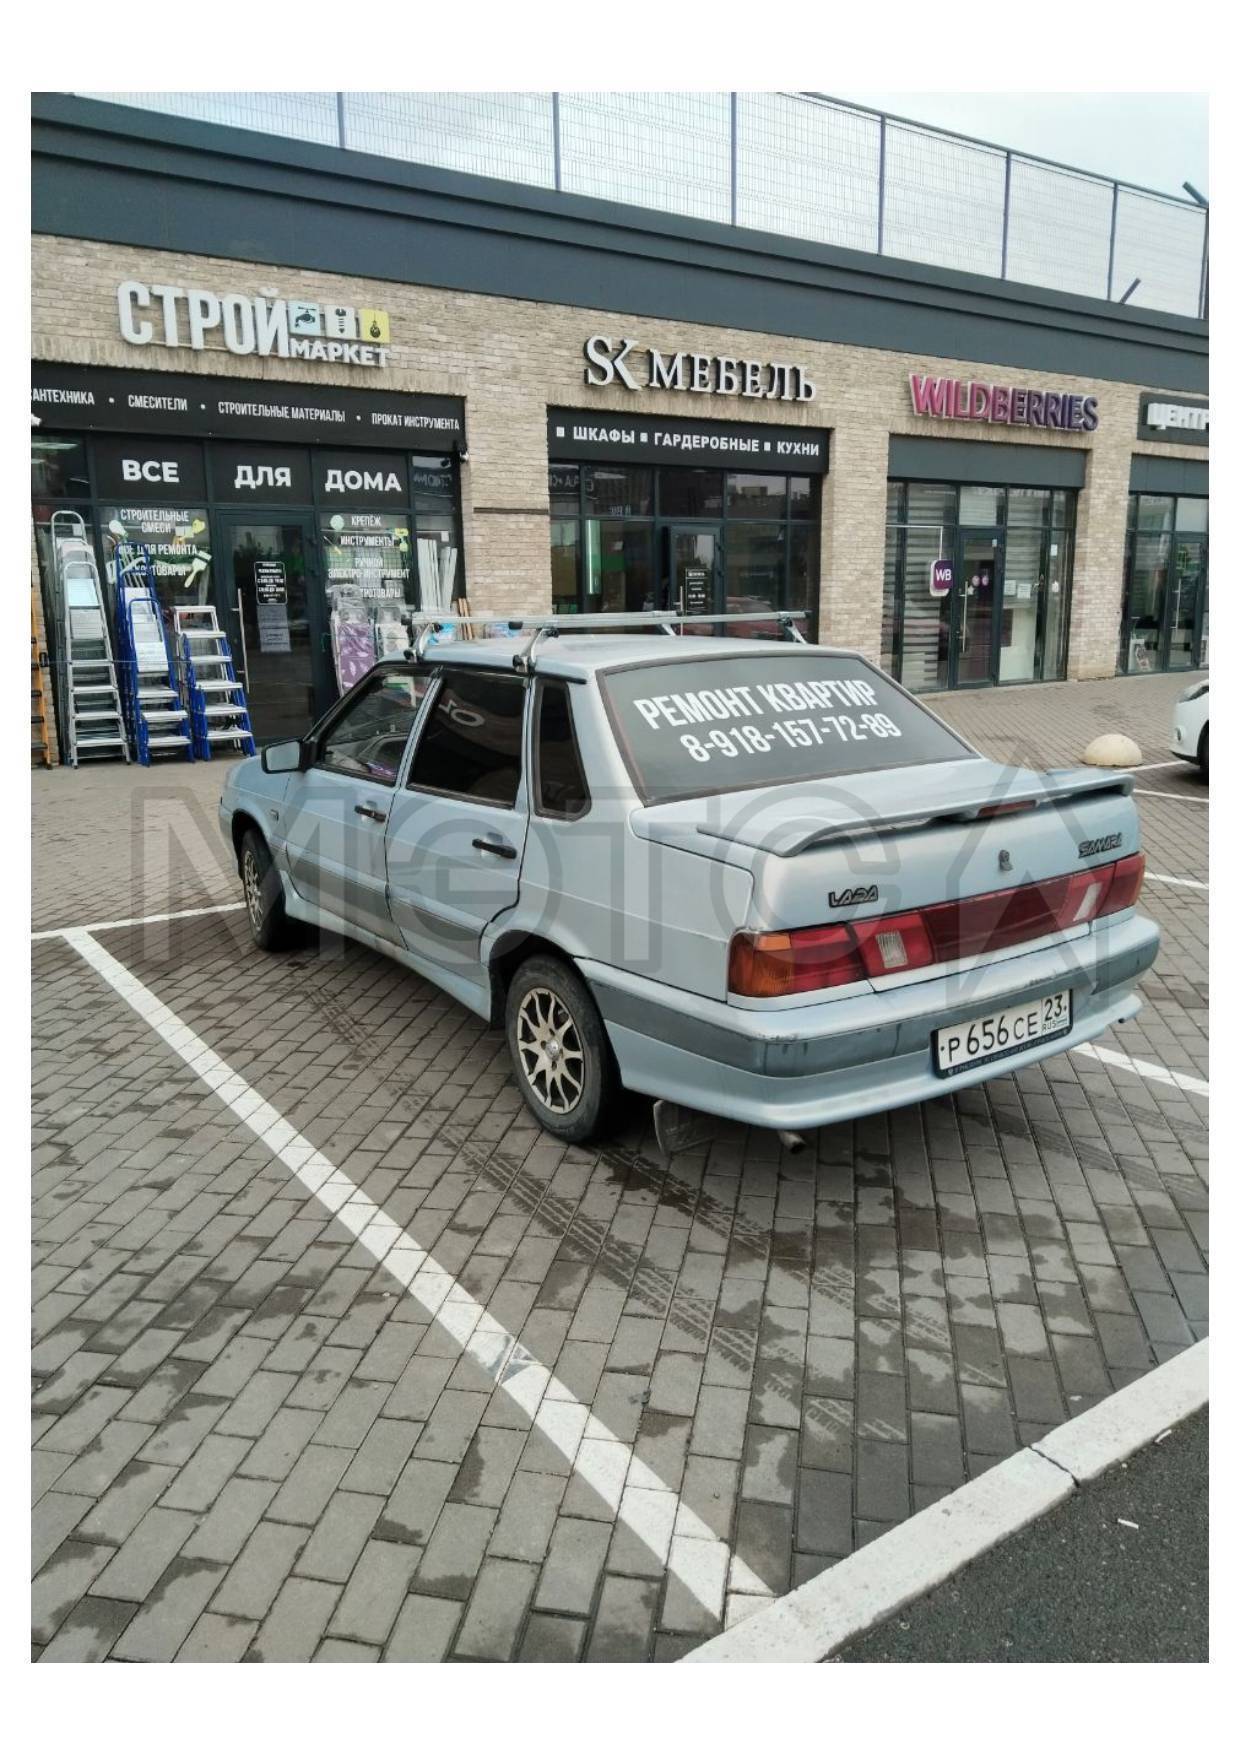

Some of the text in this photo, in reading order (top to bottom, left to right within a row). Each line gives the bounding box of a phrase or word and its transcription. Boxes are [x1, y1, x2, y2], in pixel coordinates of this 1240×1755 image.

[117, 280, 290, 357] СТРОЙ
[288, 337, 391, 368] МАРКЕТ
[584, 335, 818, 402] SK МЕБЕЛЬ
[31, 388, 460, 430] АНТЕХНИКА СМЕСИТЕЛИ СТРОИТЕЛЬНЫЕ МАТЕРИАЛЫ ПРОКАТ ИНСТРУМЕНТА
[908, 374, 1100, 433] WILDBERRIES
[573, 425, 819, 456] ШКАФЫ ГАРДЕРОБНЫЕ КУХНИ
[122, 459, 180, 483] ВСЕ
[234, 465, 292, 489] ДЛЯ
[324, 469, 402, 492] ДОМА
[120, 508, 190, 522] СТРОИТЕЛЬНЫЕ
[141, 522, 171, 533] СМЕСИ
[158, 543, 198, 555] РЕМОНТА
[340, 535, 394, 547] ИНСТРУМЕНТЫ
[935, 568, 952, 582] WB
[633, 679, 879, 730] РЕМОНТ КВАРТИР
[680, 713, 902, 763] 8-918-157-72-89
[829, 885, 878, 908] LADA
[1044, 994, 1063, 1022] 23
[1042, 1021, 1057, 1033] RUS
